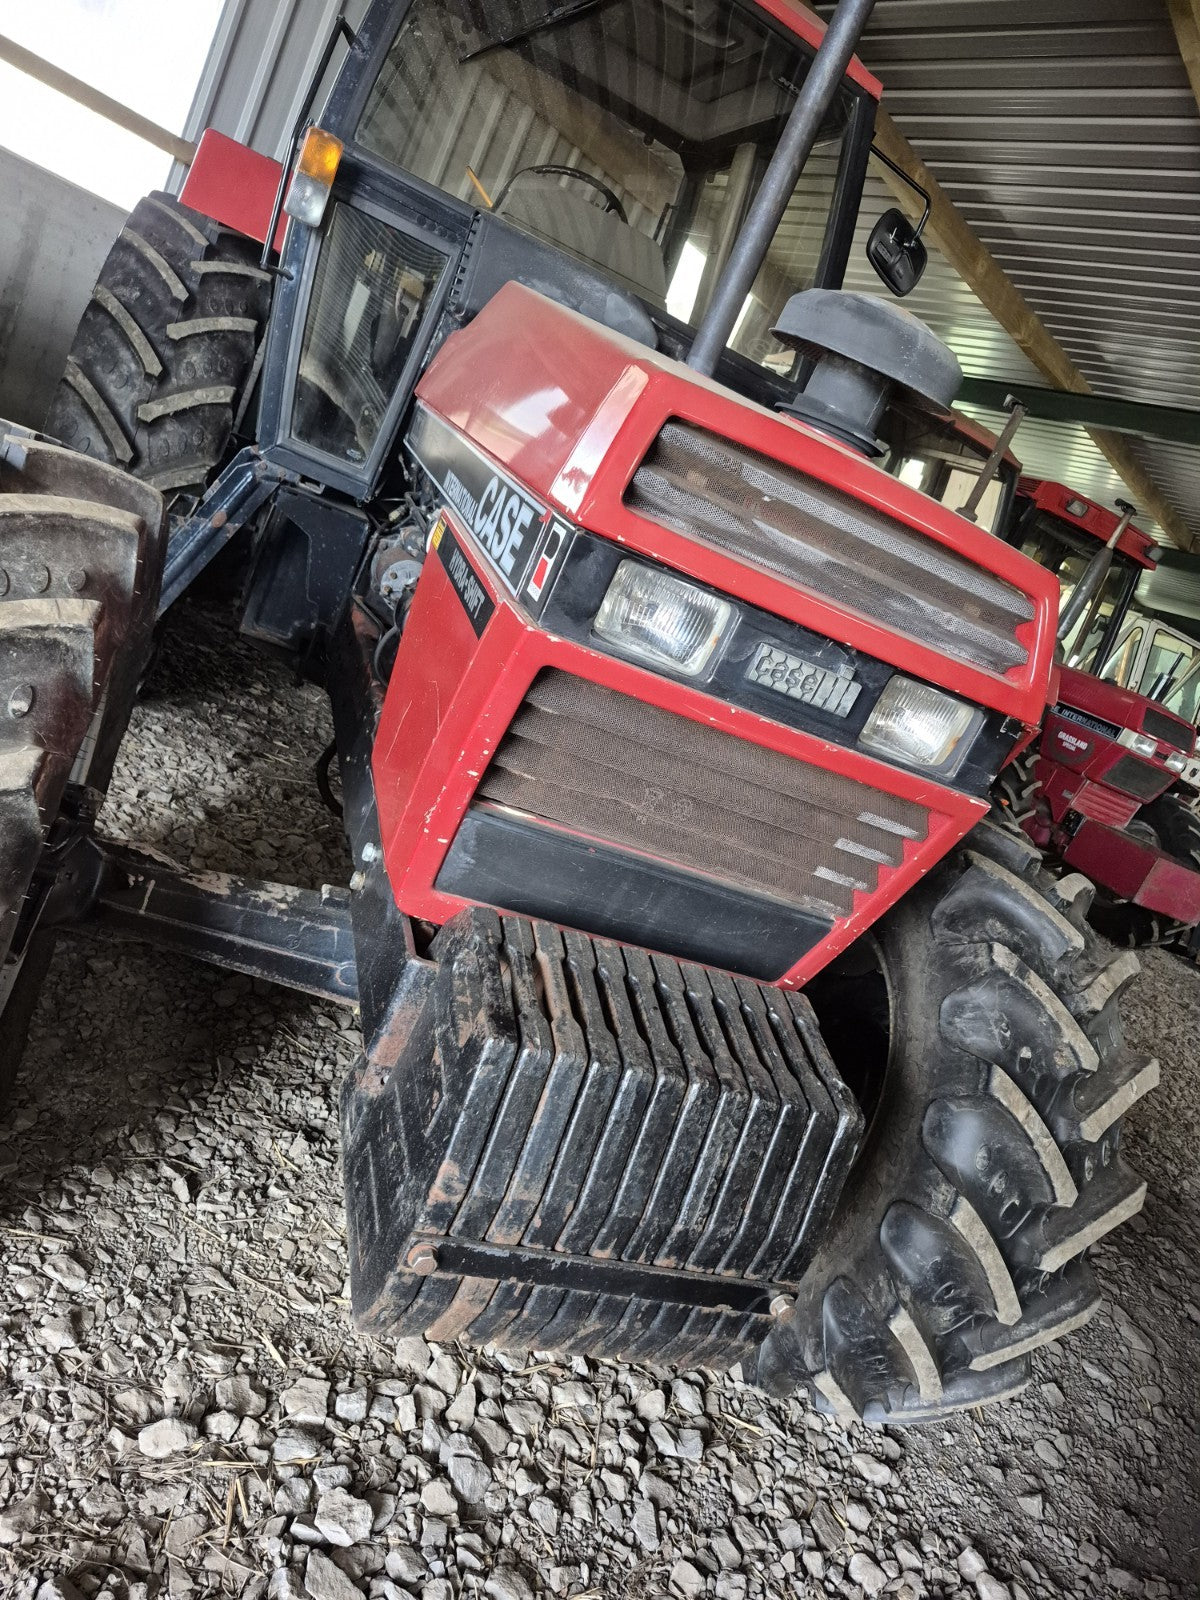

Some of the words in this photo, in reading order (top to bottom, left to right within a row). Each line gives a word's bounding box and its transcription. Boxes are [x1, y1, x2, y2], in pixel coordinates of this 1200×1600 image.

[474, 475, 535, 577] CASE
[1061, 709, 1115, 738] INTERNATIONAL
[1058, 731, 1088, 750] GRASSLAND
